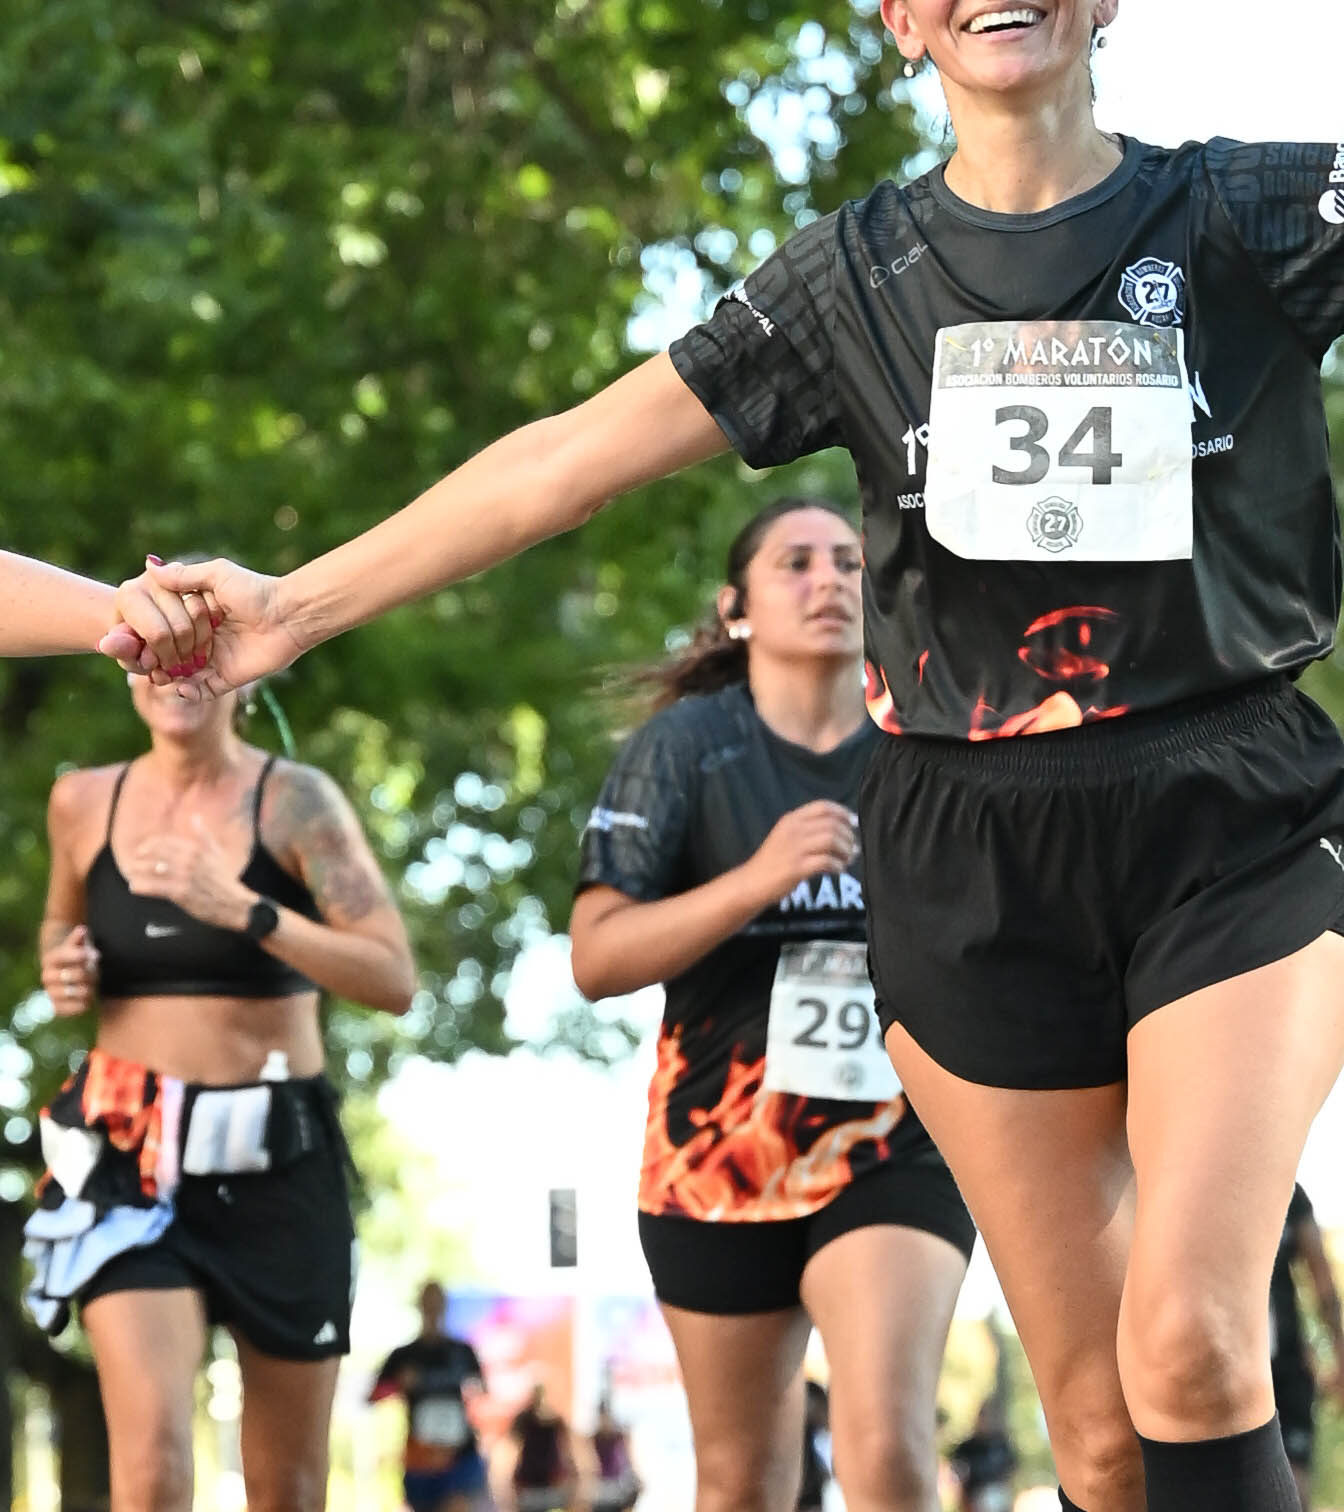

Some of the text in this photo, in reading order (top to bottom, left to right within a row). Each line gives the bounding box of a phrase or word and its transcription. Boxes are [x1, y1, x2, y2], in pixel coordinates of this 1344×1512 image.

[1142, 280, 1170, 304] 27
[1002, 328, 1152, 366] MARATÓN
[1006, 373, 1061, 386] BOMBEROS
[1064, 373, 1132, 386] VOLUNTARIOS
[1135, 374, 1178, 386] ROSARIO
[992, 404, 1122, 485] 34
[1192, 434, 1234, 459] OSARIO
[1044, 513, 1067, 533] 27
[779, 873, 866, 912] MAR
[792, 997, 885, 1051] 29
